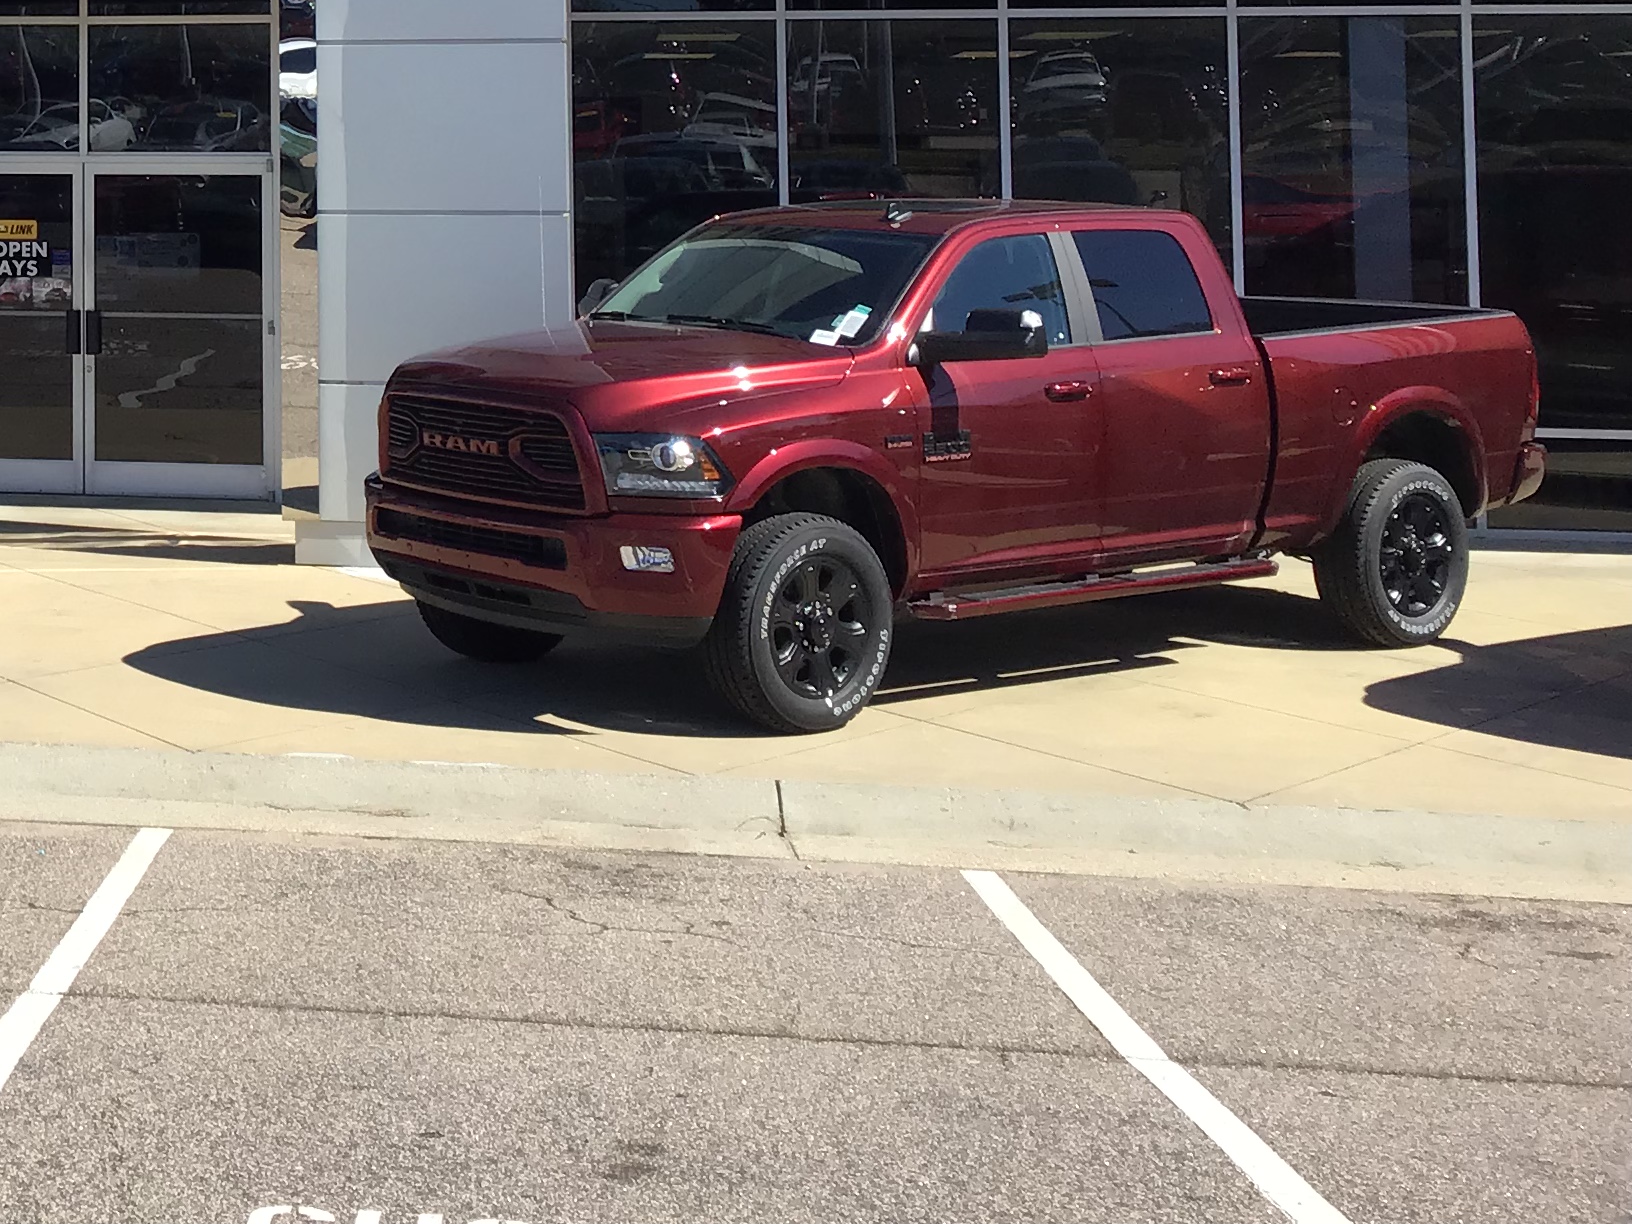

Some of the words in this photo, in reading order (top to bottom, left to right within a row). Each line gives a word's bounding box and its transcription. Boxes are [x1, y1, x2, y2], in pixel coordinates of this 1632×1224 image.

[9, 223, 34, 235] LINK
[422, 431, 501, 456] RAM
[809, 538, 827, 552] AT
